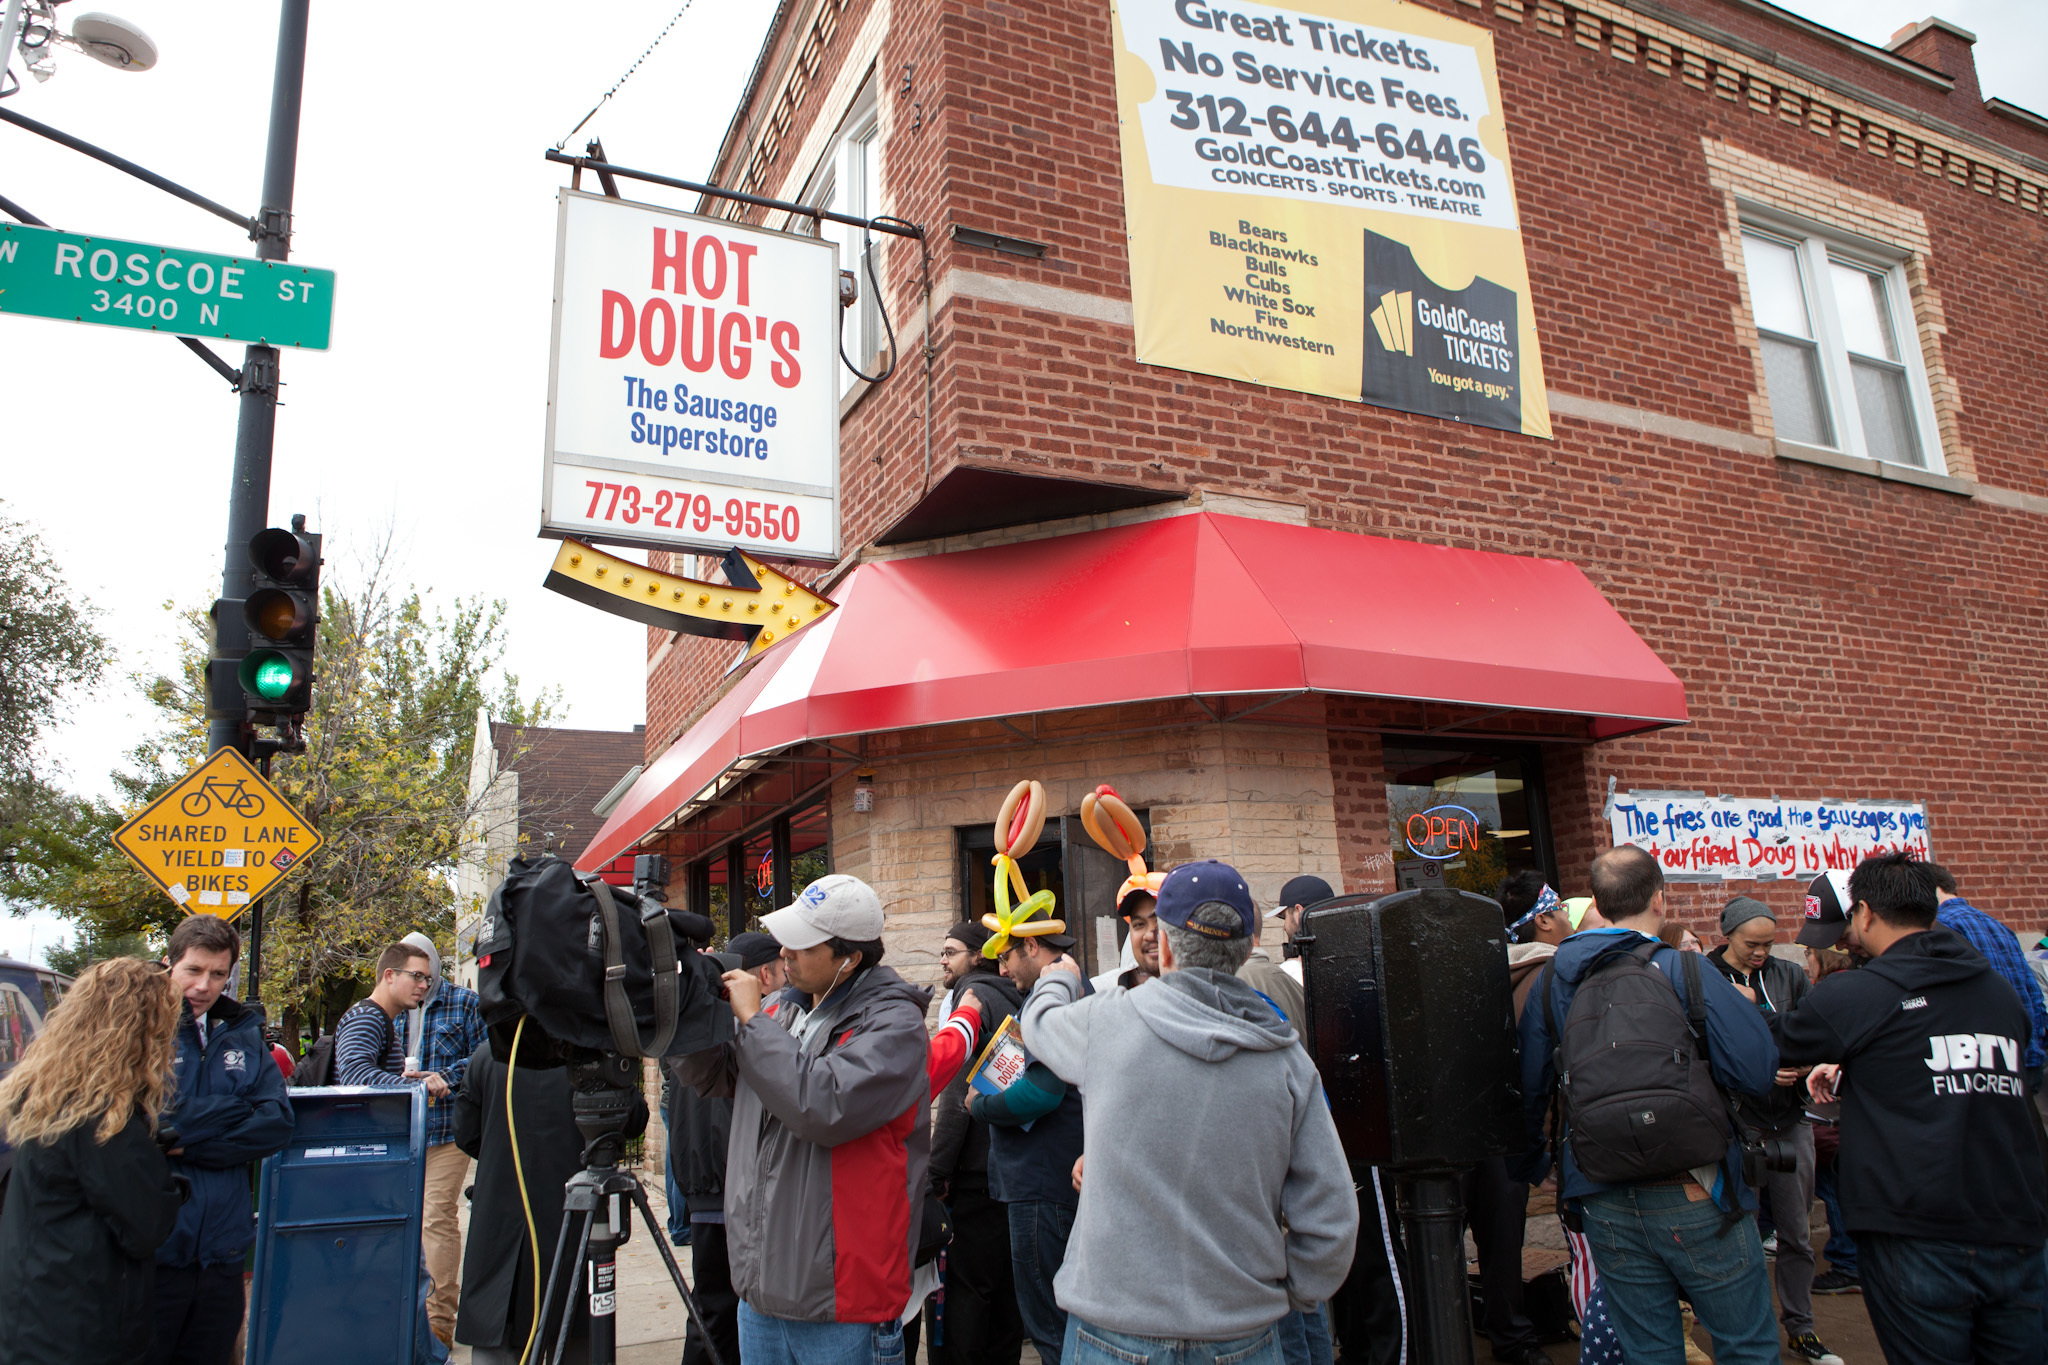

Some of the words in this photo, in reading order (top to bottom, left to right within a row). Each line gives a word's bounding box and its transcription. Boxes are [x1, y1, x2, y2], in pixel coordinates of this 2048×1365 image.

[1174, 0, 1293, 45] Great
[1299, 18, 1440, 73] Tickets.
[1158, 38, 1224, 80] No
[1231, 50, 1375, 105] Service
[1380, 77, 1470, 122] Fees.
[1165, 89, 1486, 174] 312-644-6446
[1194, 137, 1487, 200] GoldCoastTickets.com
[1211, 168, 1318, 194] CONCERTS
[1328, 182, 1397, 205] SPORTS
[1406, 192, 1482, 218] THEATRE
[1209, 231, 1319, 268] Blackhawks
[1238, 219, 1288, 244] Bears
[0, 241, 19, 264] W
[54, 243, 246, 300] ROSCOE
[277, 279, 315, 304] ST
[651, 227, 758, 307] HOT
[1245, 256, 1287, 279] Bulls
[1245, 274, 1291, 296] Cubs
[91, 289, 179, 321] 3400
[200, 304, 220, 326] N
[1223, 285, 1278, 313] White
[1282, 296, 1316, 318] Sox
[1255, 309, 1288, 331] Fire
[599, 289, 802, 389] DOUG'S
[1210, 318, 1335, 357] Northwestern
[1417, 298, 1508, 346] GoldCoast
[1427, 367, 1452, 387] You
[1453, 376, 1474, 393] got
[1474, 381, 1483, 393] a
[624, 375, 668, 412] The
[674, 384, 778, 433] Sausage
[630, 411, 769, 461] Superstore
[585, 480, 800, 542] 773-279-9550
[138, 824, 227, 842] SHARED
[244, 826, 300, 844] LANE
[1406, 813, 1479, 851] OPEN
[1615, 800, 1660, 837] The
[1663, 803, 1706, 842] fries
[1711, 810, 1743, 828] are
[1788, 806, 1813, 828] the
[1818, 806, 1898, 842] sausages
[162, 850, 223, 867] YIELD
[244, 850, 265, 868] TO
[1742, 837, 1796, 877] Doug
[1801, 836, 1819, 871] is
[1822, 832, 1858, 870] why
[187, 875, 249, 892] BIKES
[757, 859, 773, 889] OPE
[993, 1053, 1010, 1072] HOT
[997, 1054, 1025, 1086] DOUG'S
[1924, 1033, 2019, 1074] JBTV
[1972, 1073, 2024, 1097] CREW
